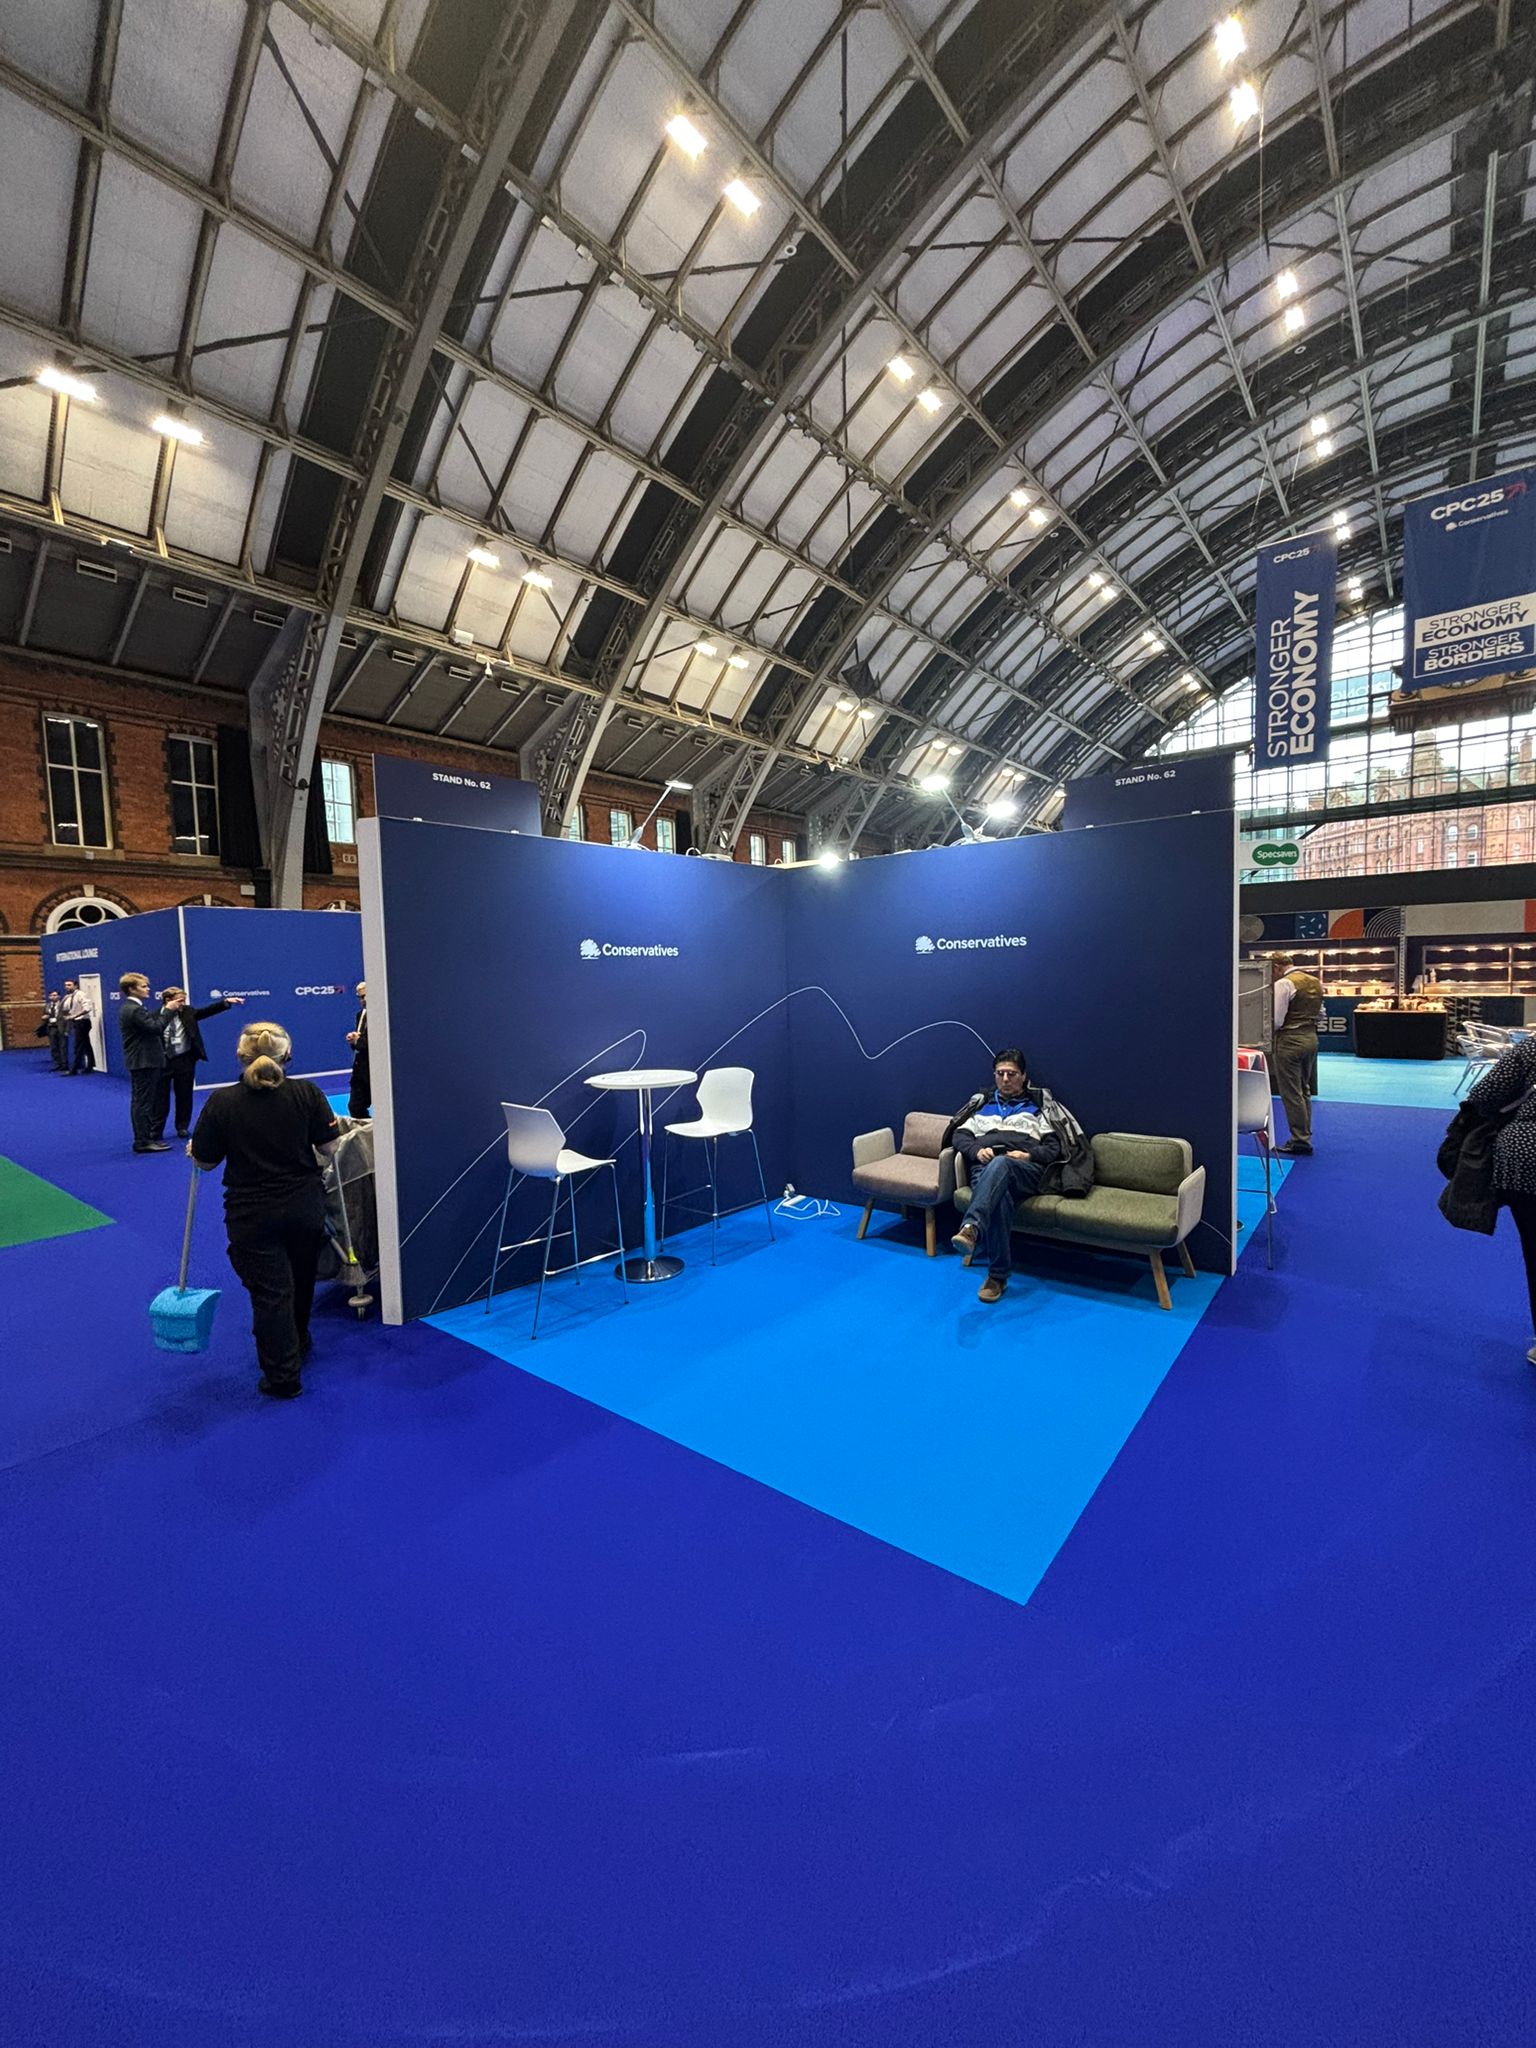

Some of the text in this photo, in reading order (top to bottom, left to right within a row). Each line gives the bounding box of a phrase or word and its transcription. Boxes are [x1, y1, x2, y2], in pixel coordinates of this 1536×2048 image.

[1430, 488, 1505, 521] CPC25
[1457, 508, 1510, 528] Conservatives
[1273, 548, 1310, 564] CPC25
[1429, 601, 1521, 630] STRONGER
[1422, 609, 1529, 643] ECONOMY
[1428, 631, 1521, 659] STRONGER
[1424, 641, 1525, 672] BORDERS
[1290, 590, 1320, 755] ECONOMY
[1267, 616, 1291, 758] STRONGER
[432, 772, 492, 790] STAND No. 62
[1115, 770, 1176, 787] STAND No. 62
[1256, 850, 1298, 860] Specsavers
[602, 943, 679, 957] Conservatives
[936, 934, 1027, 950] Conservatives
[222, 989, 270, 997] Conservatives
[295, 986, 335, 996] CPC25
